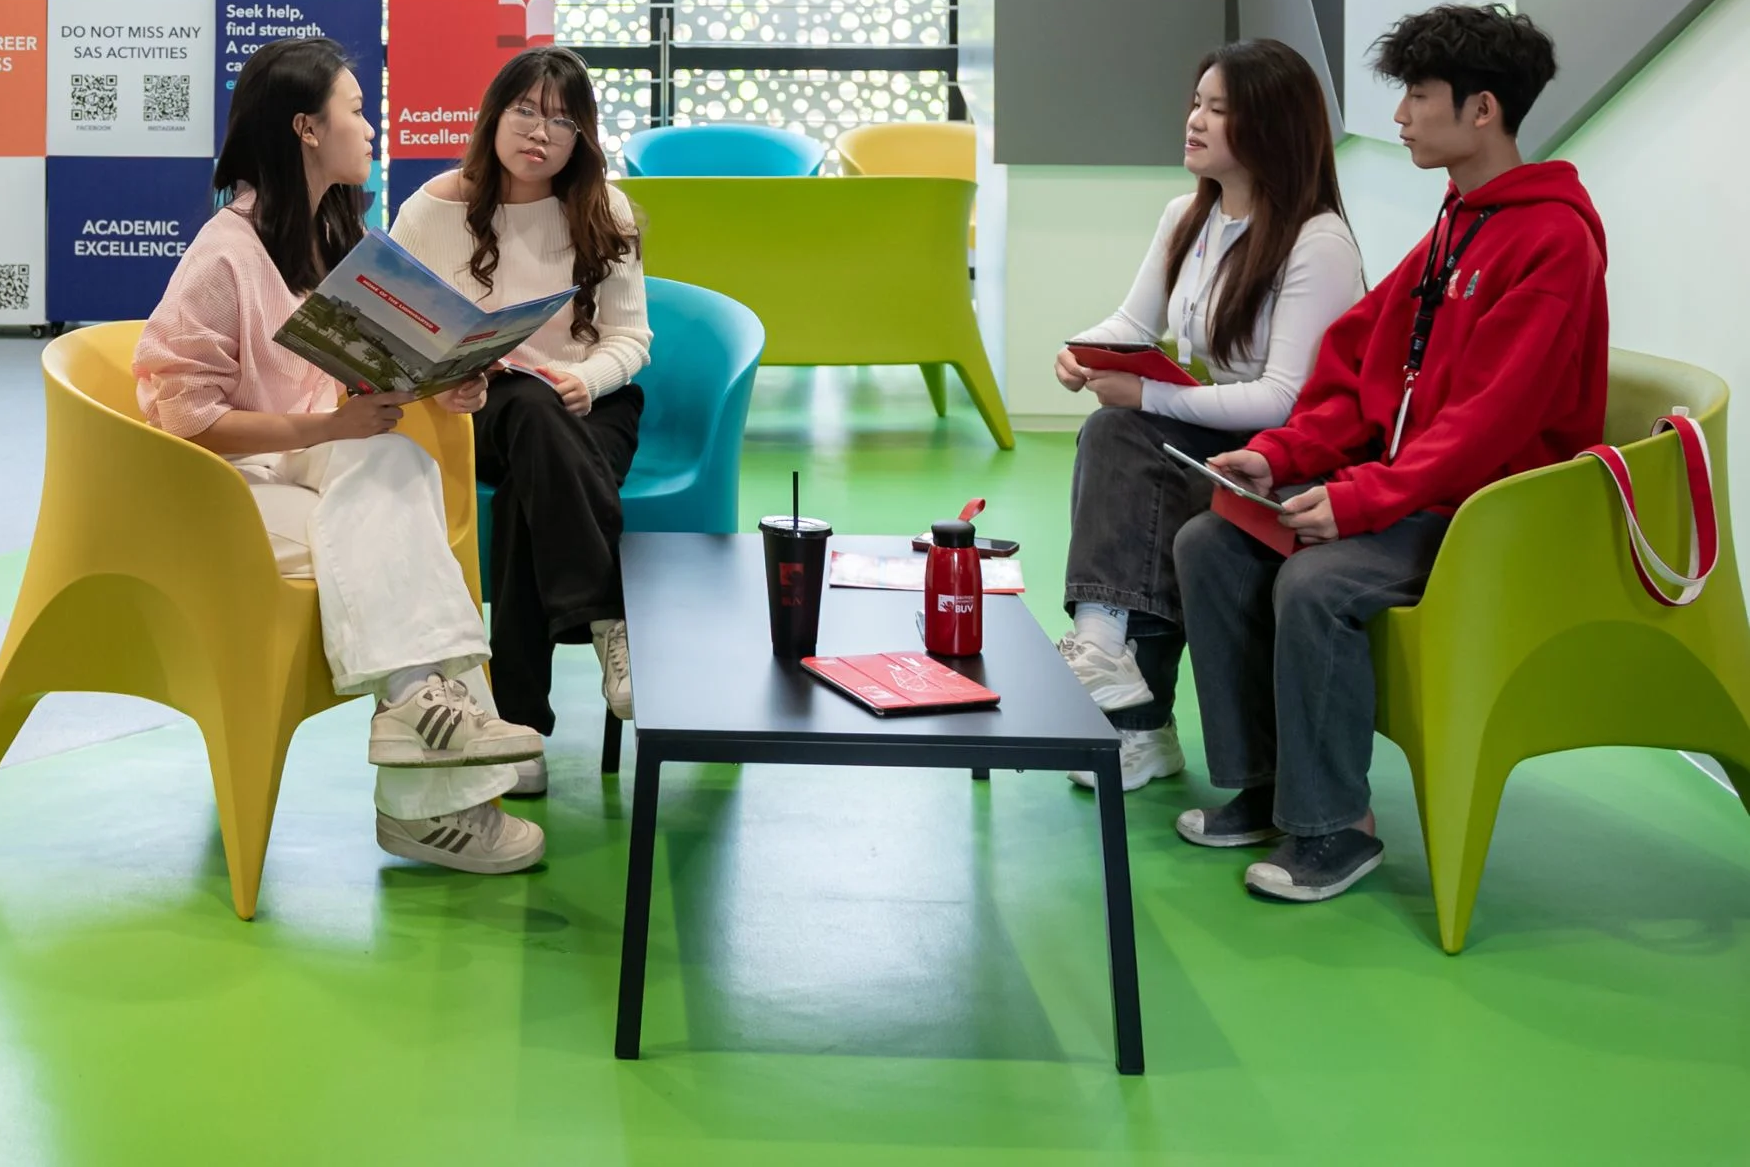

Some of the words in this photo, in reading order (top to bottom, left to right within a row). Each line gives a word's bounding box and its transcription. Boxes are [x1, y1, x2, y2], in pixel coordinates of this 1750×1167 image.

[226, 4, 264, 18] Seek
[267, 4, 304, 21] help,
[61, 26, 86, 38] DO
[91, 26, 124, 38] NOT
[128, 26, 164, 39] MISS
[168, 27, 202, 39] ANY
[225, 22, 256, 36] find
[259, 22, 326, 39] strength.
[74, 46, 102, 59] SAS
[106, 46, 188, 59] ACTIVITIES
[225, 40, 238, 54] A
[400, 129, 470, 145] Excellen
[82, 220, 180, 236] ACADEMIC
[74, 240, 187, 257] EXCELLENCE
[955, 604, 974, 613] BUV
